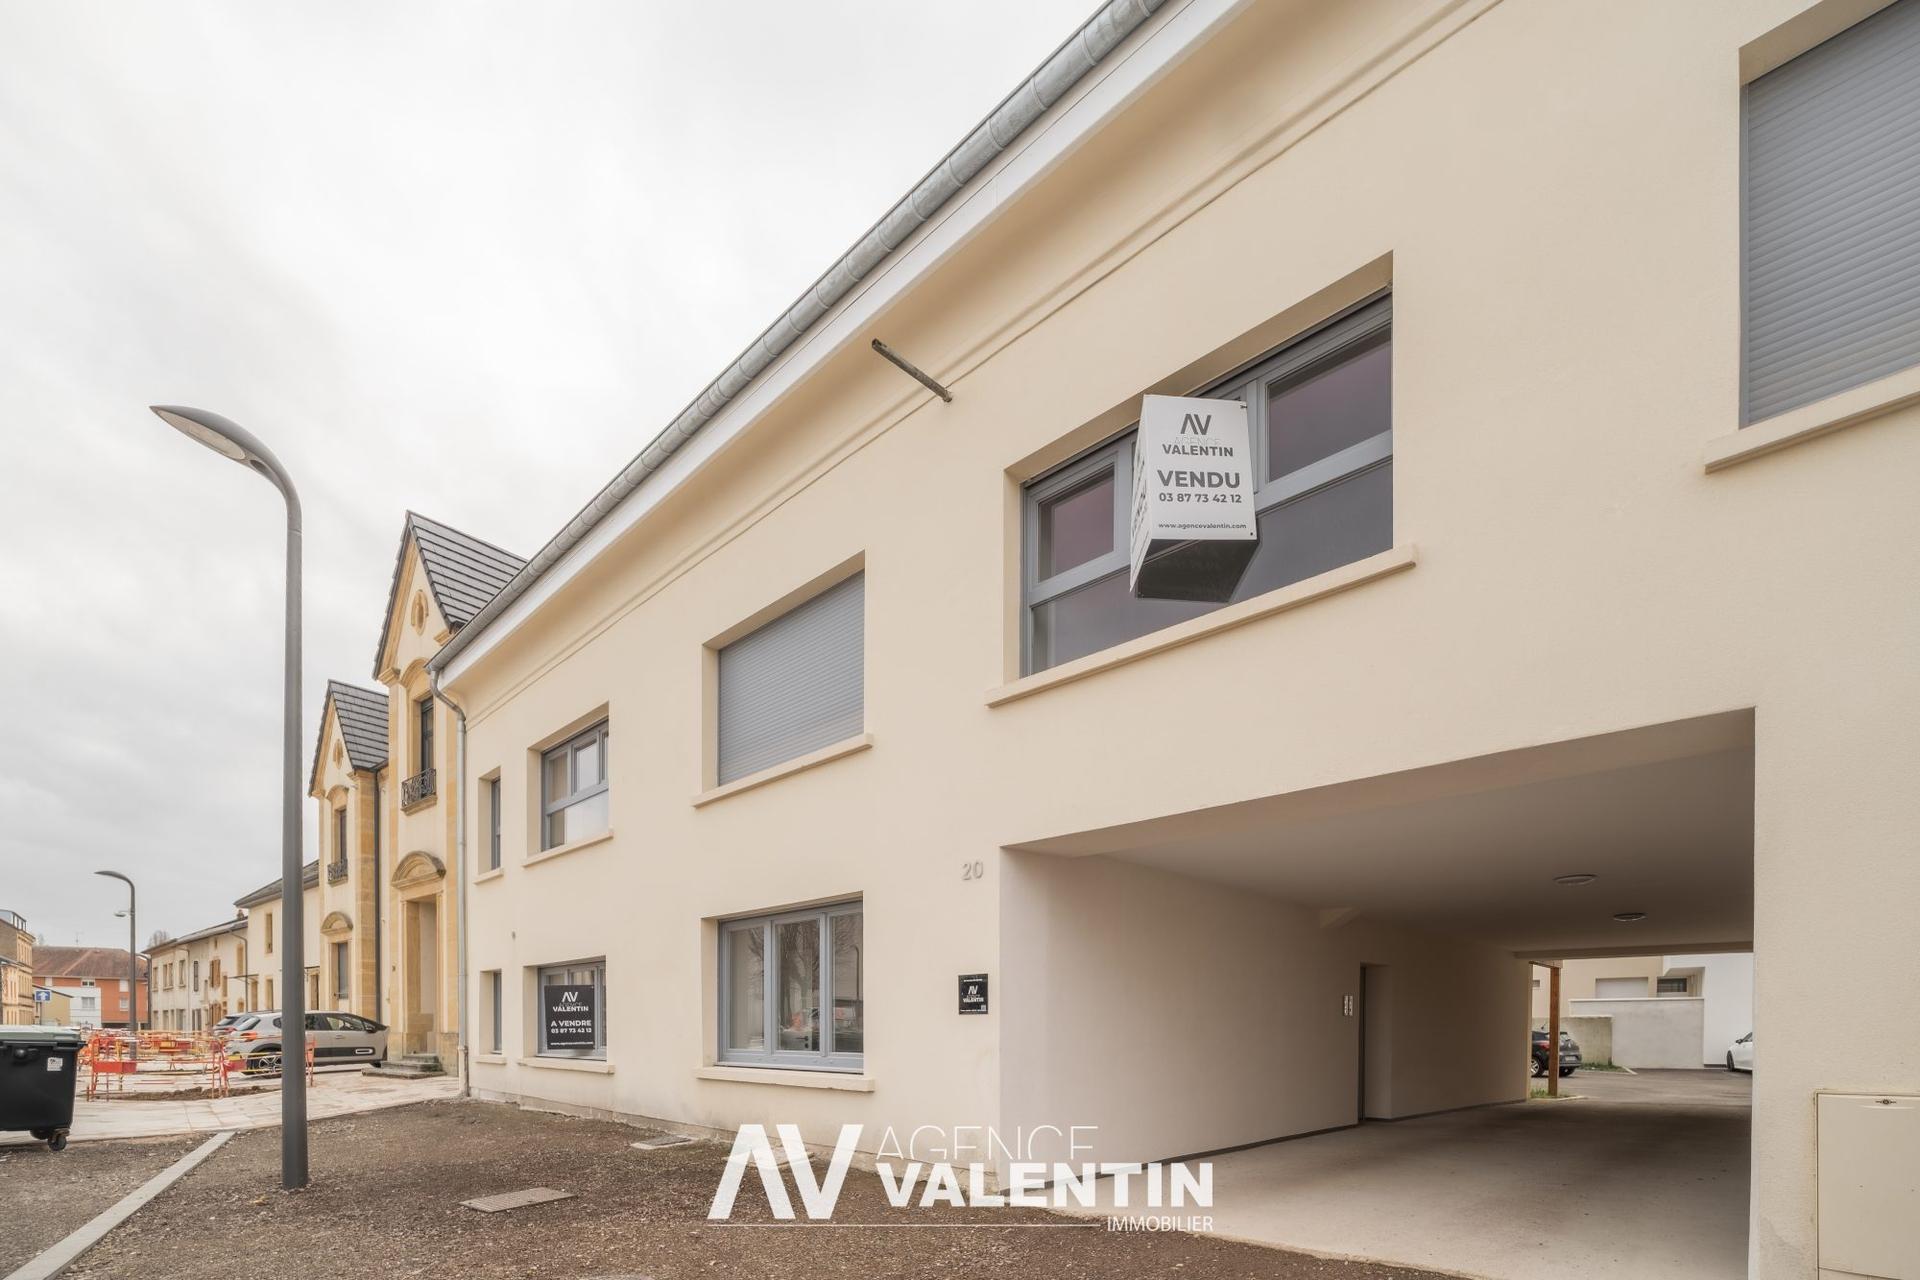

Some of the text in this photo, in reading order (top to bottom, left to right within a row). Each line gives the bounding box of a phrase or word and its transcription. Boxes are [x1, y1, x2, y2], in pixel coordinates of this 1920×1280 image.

[1162, 443, 1234, 457] VALENTIN
[1157, 469, 1240, 489] VENDU
[1159, 492, 1242, 504] 03 87 73 42 12
[962, 861, 984, 881] 20
